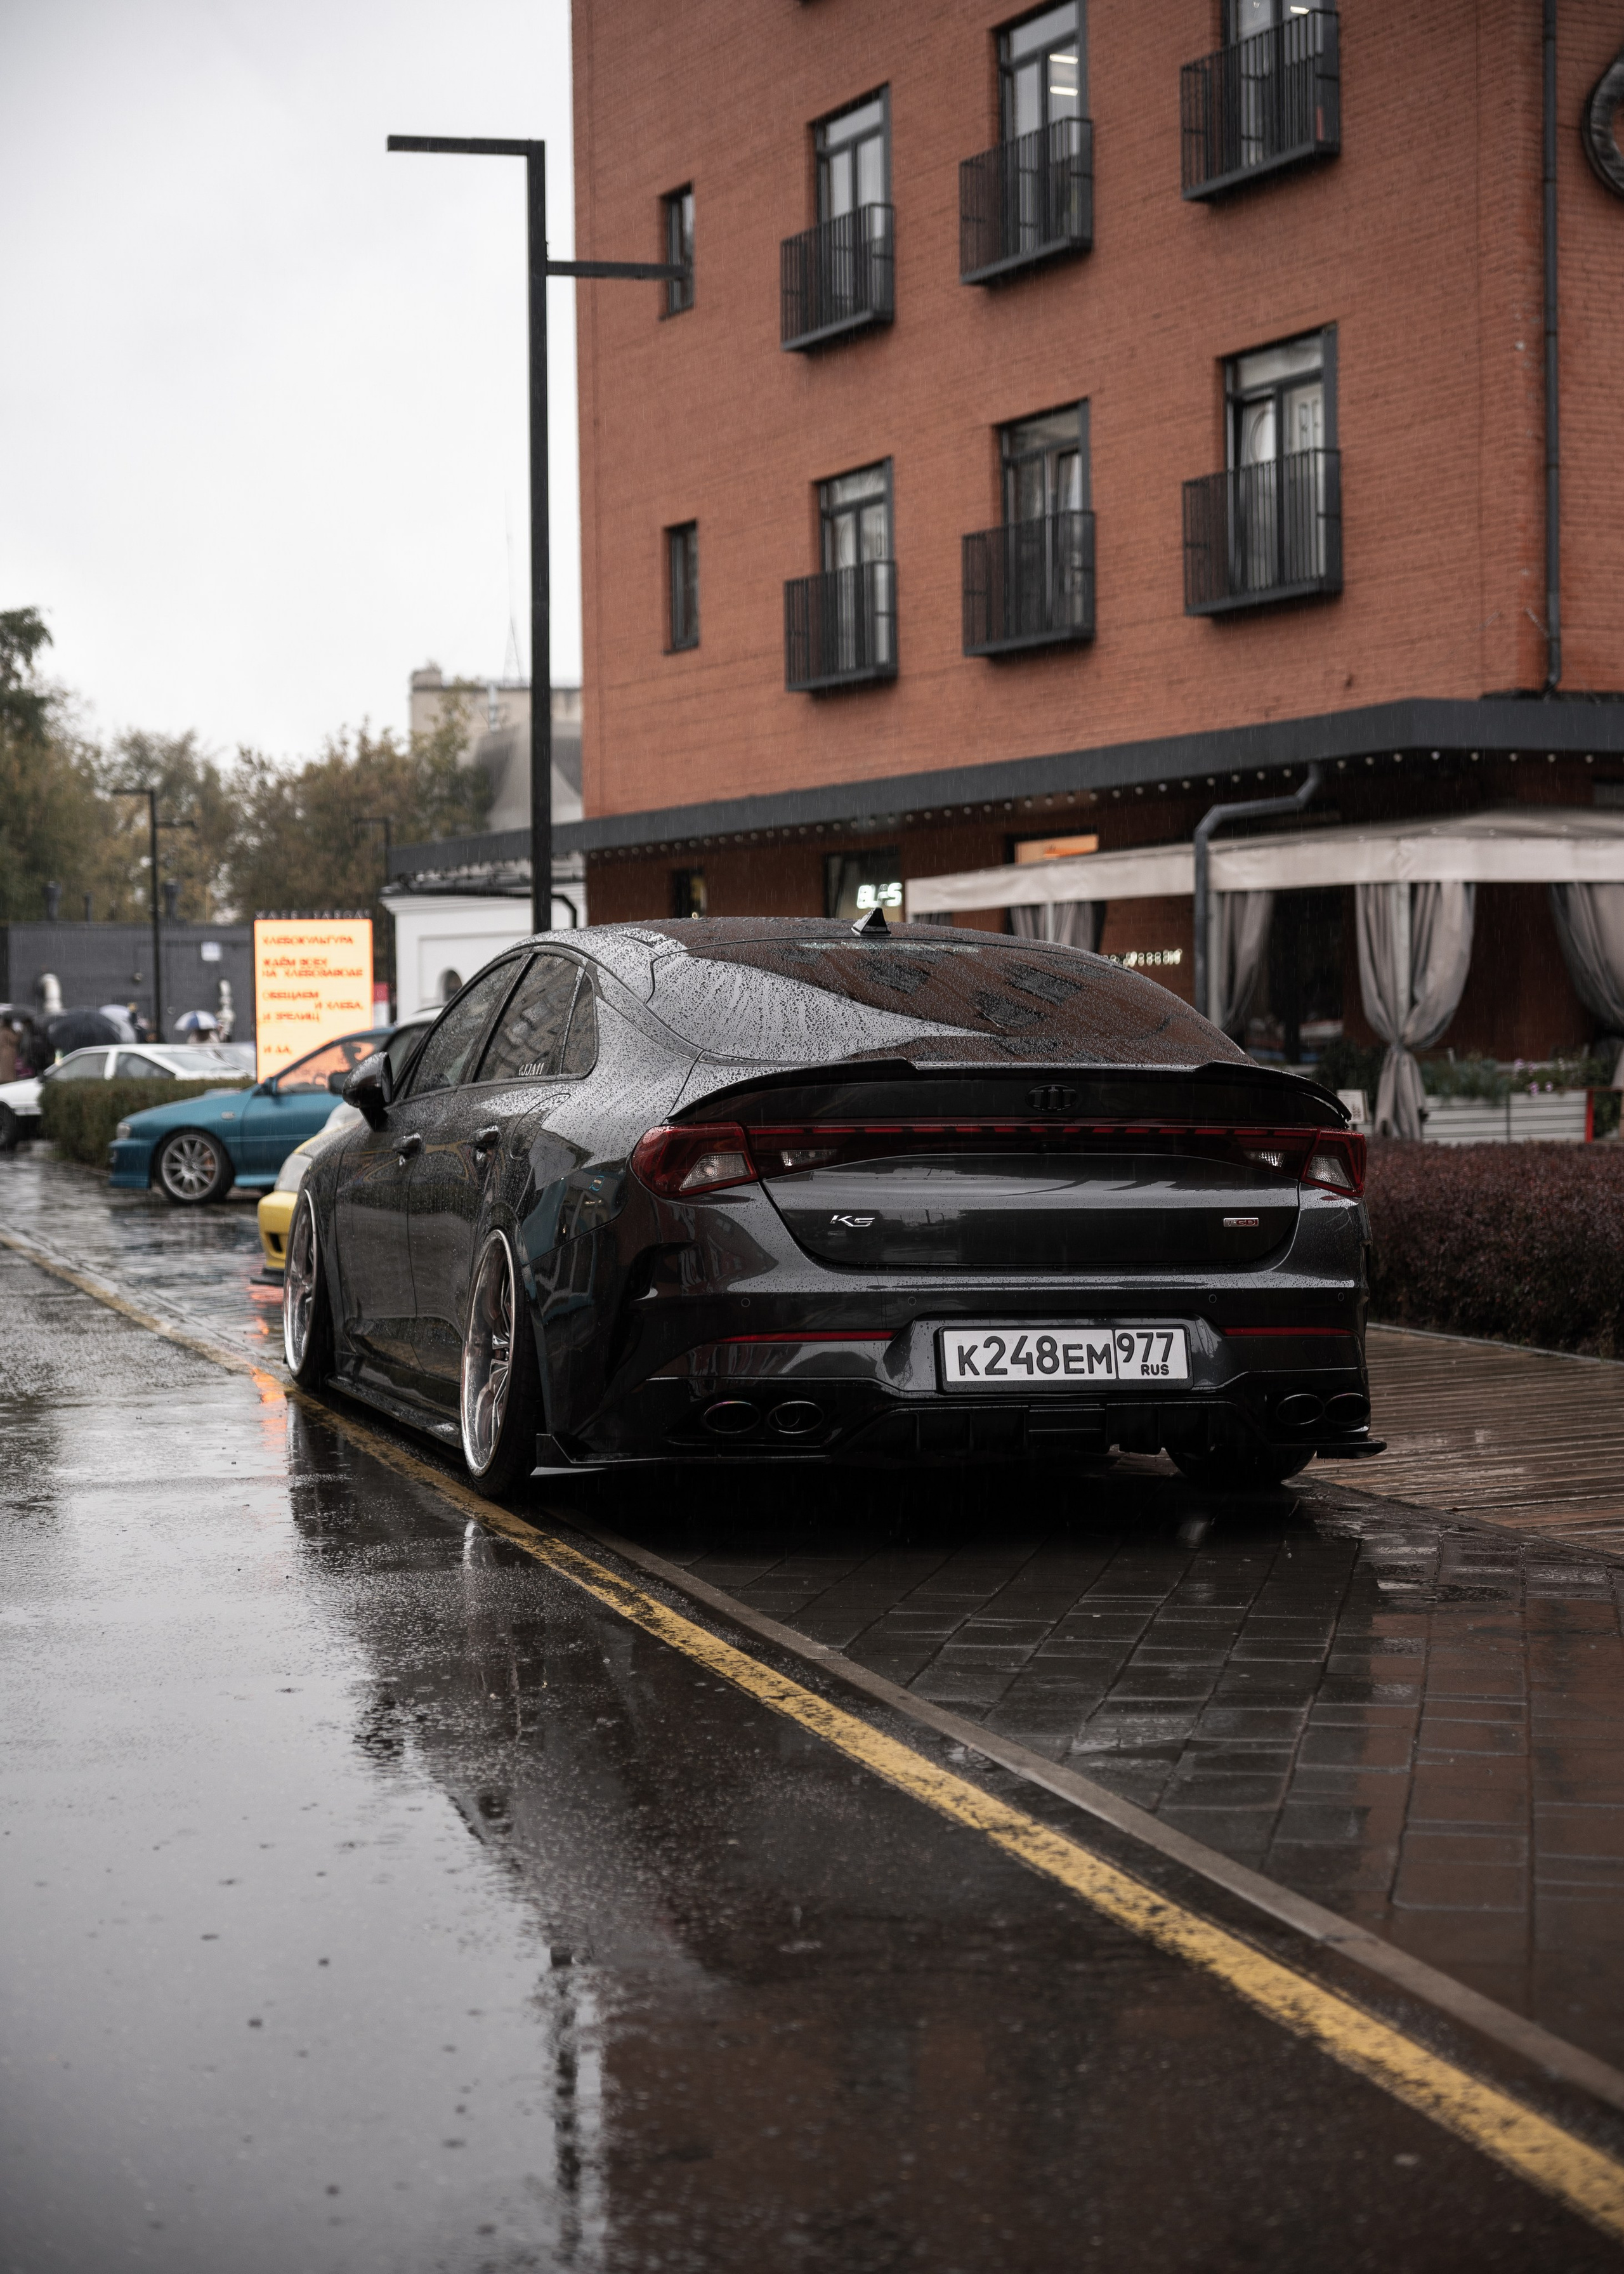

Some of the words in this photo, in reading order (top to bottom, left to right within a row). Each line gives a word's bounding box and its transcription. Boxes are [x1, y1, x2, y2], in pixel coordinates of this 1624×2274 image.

[829, 1215, 875, 1227] K5
[1116, 1332, 1174, 1363] 977
[1141, 1364, 1170, 1376] RUS
